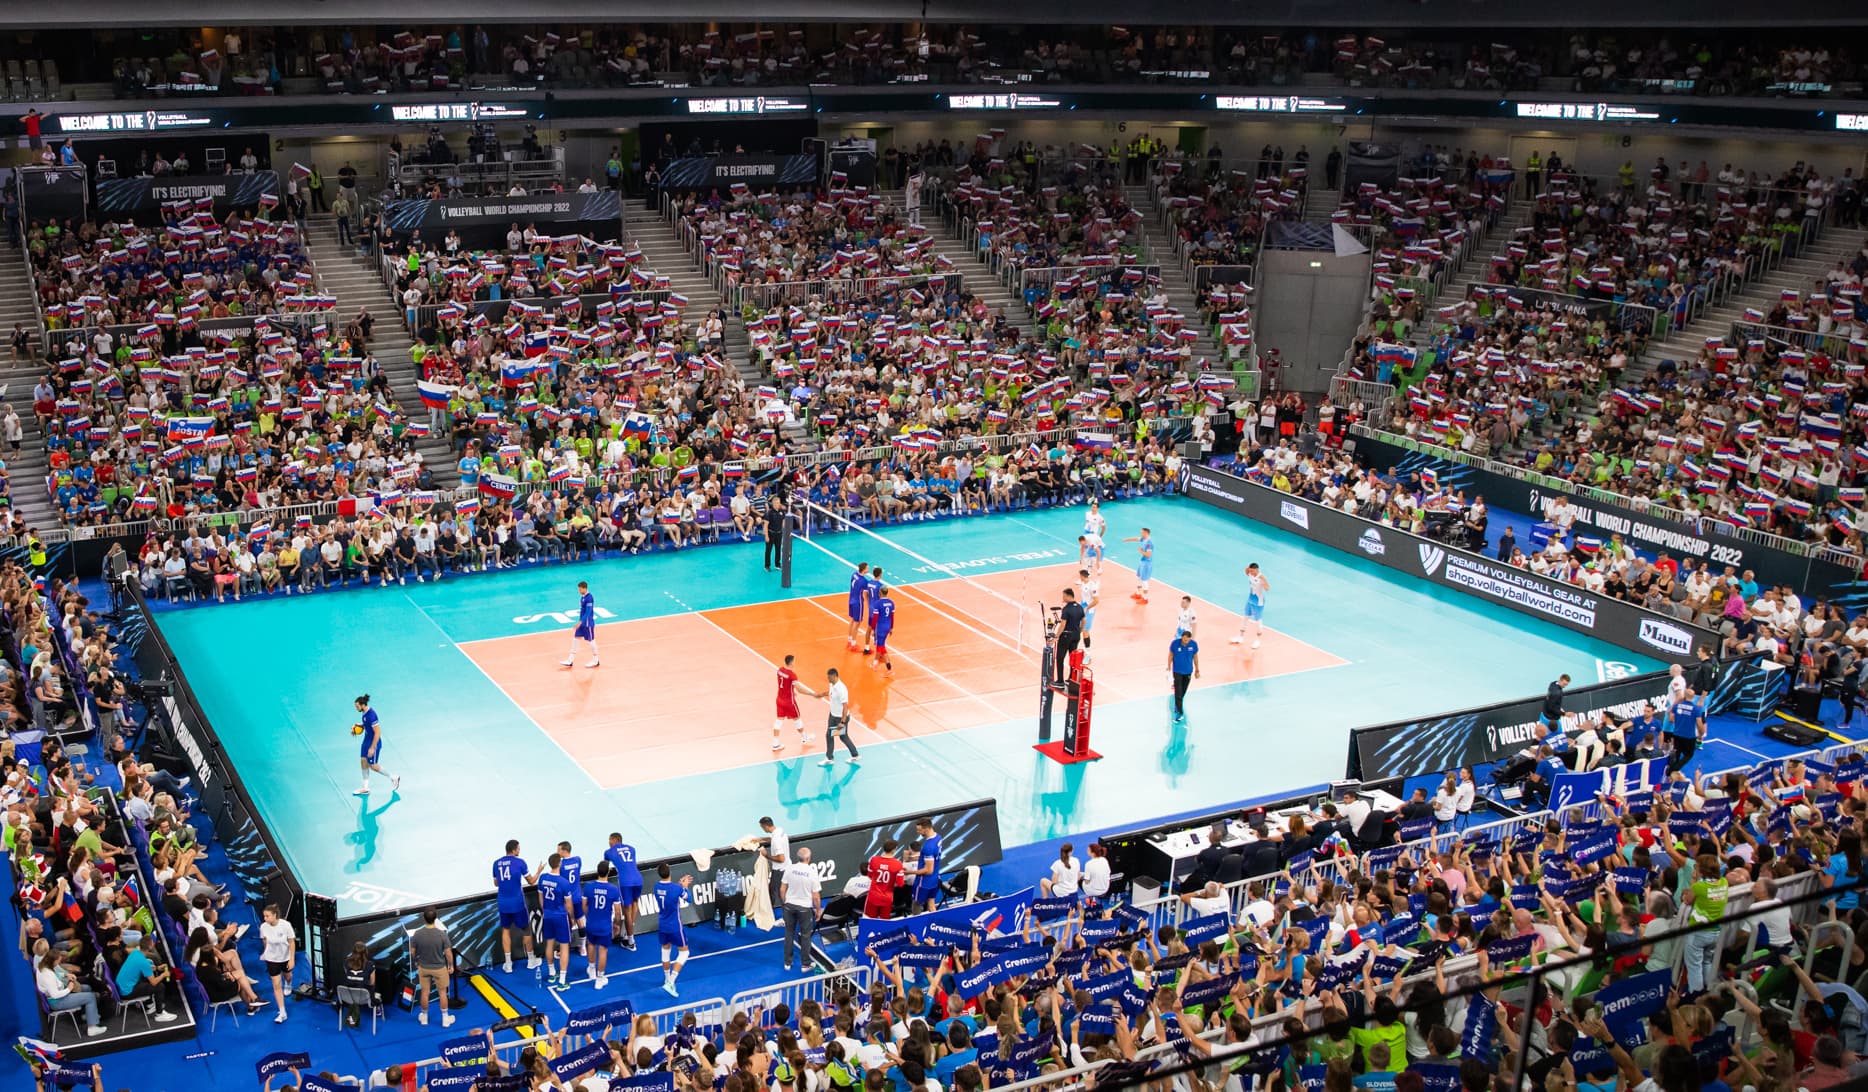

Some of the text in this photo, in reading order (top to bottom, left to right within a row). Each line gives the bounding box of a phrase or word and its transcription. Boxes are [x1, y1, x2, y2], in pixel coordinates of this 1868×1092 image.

[688, 99, 754, 113] WELCOME TO THE
[949, 96, 984, 108] WELCOME
[985, 96, 994, 108] TO
[996, 96, 1008, 107] THE
[1216, 97, 1257, 109] WELCOME
[1259, 97, 1270, 109] TO
[1272, 98, 1287, 109] THE
[392, 106, 437, 120] WELCOME
[438, 106, 449, 119] TO
[451, 106, 467, 118] THE
[1517, 103, 1562, 117] WELCOME
[1564, 105, 1576, 118] TO
[1577, 106, 1594, 118] THE
[59, 114, 144, 131] WELCOME TO THE
[1118, 122, 1126, 133] 6
[560, 130, 567, 142] 3
[1622, 136, 1631, 147] 8
[275, 140, 284, 152] 2
[716, 164, 775, 176] IT'S ELECTRIFYING!
[152, 185, 226, 199] IT'S ELECTRIFYING!
[448, 202, 570, 216] VOLLEYBALL WORLD CHAMPIONSHIP 2022
[1596, 511, 1631, 535] WORLD
[1632, 523, 1710, 557] CHAMPIONSHIP
[1711, 544, 1743, 567] 2022
[912, 556, 1008, 573] SLOVEIA
[1448, 554, 1597, 610] PREMIUM VOLLEYBALL GEAR AT
[1448, 568, 1592, 625] shop.volleyballworld.com
[619, 851, 633, 862] 12
[498, 866, 511, 881] 14
[569, 870, 575, 884] 6
[876, 870, 890, 883] 20
[544, 886, 555, 901] 25
[594, 895, 606, 909] 19
